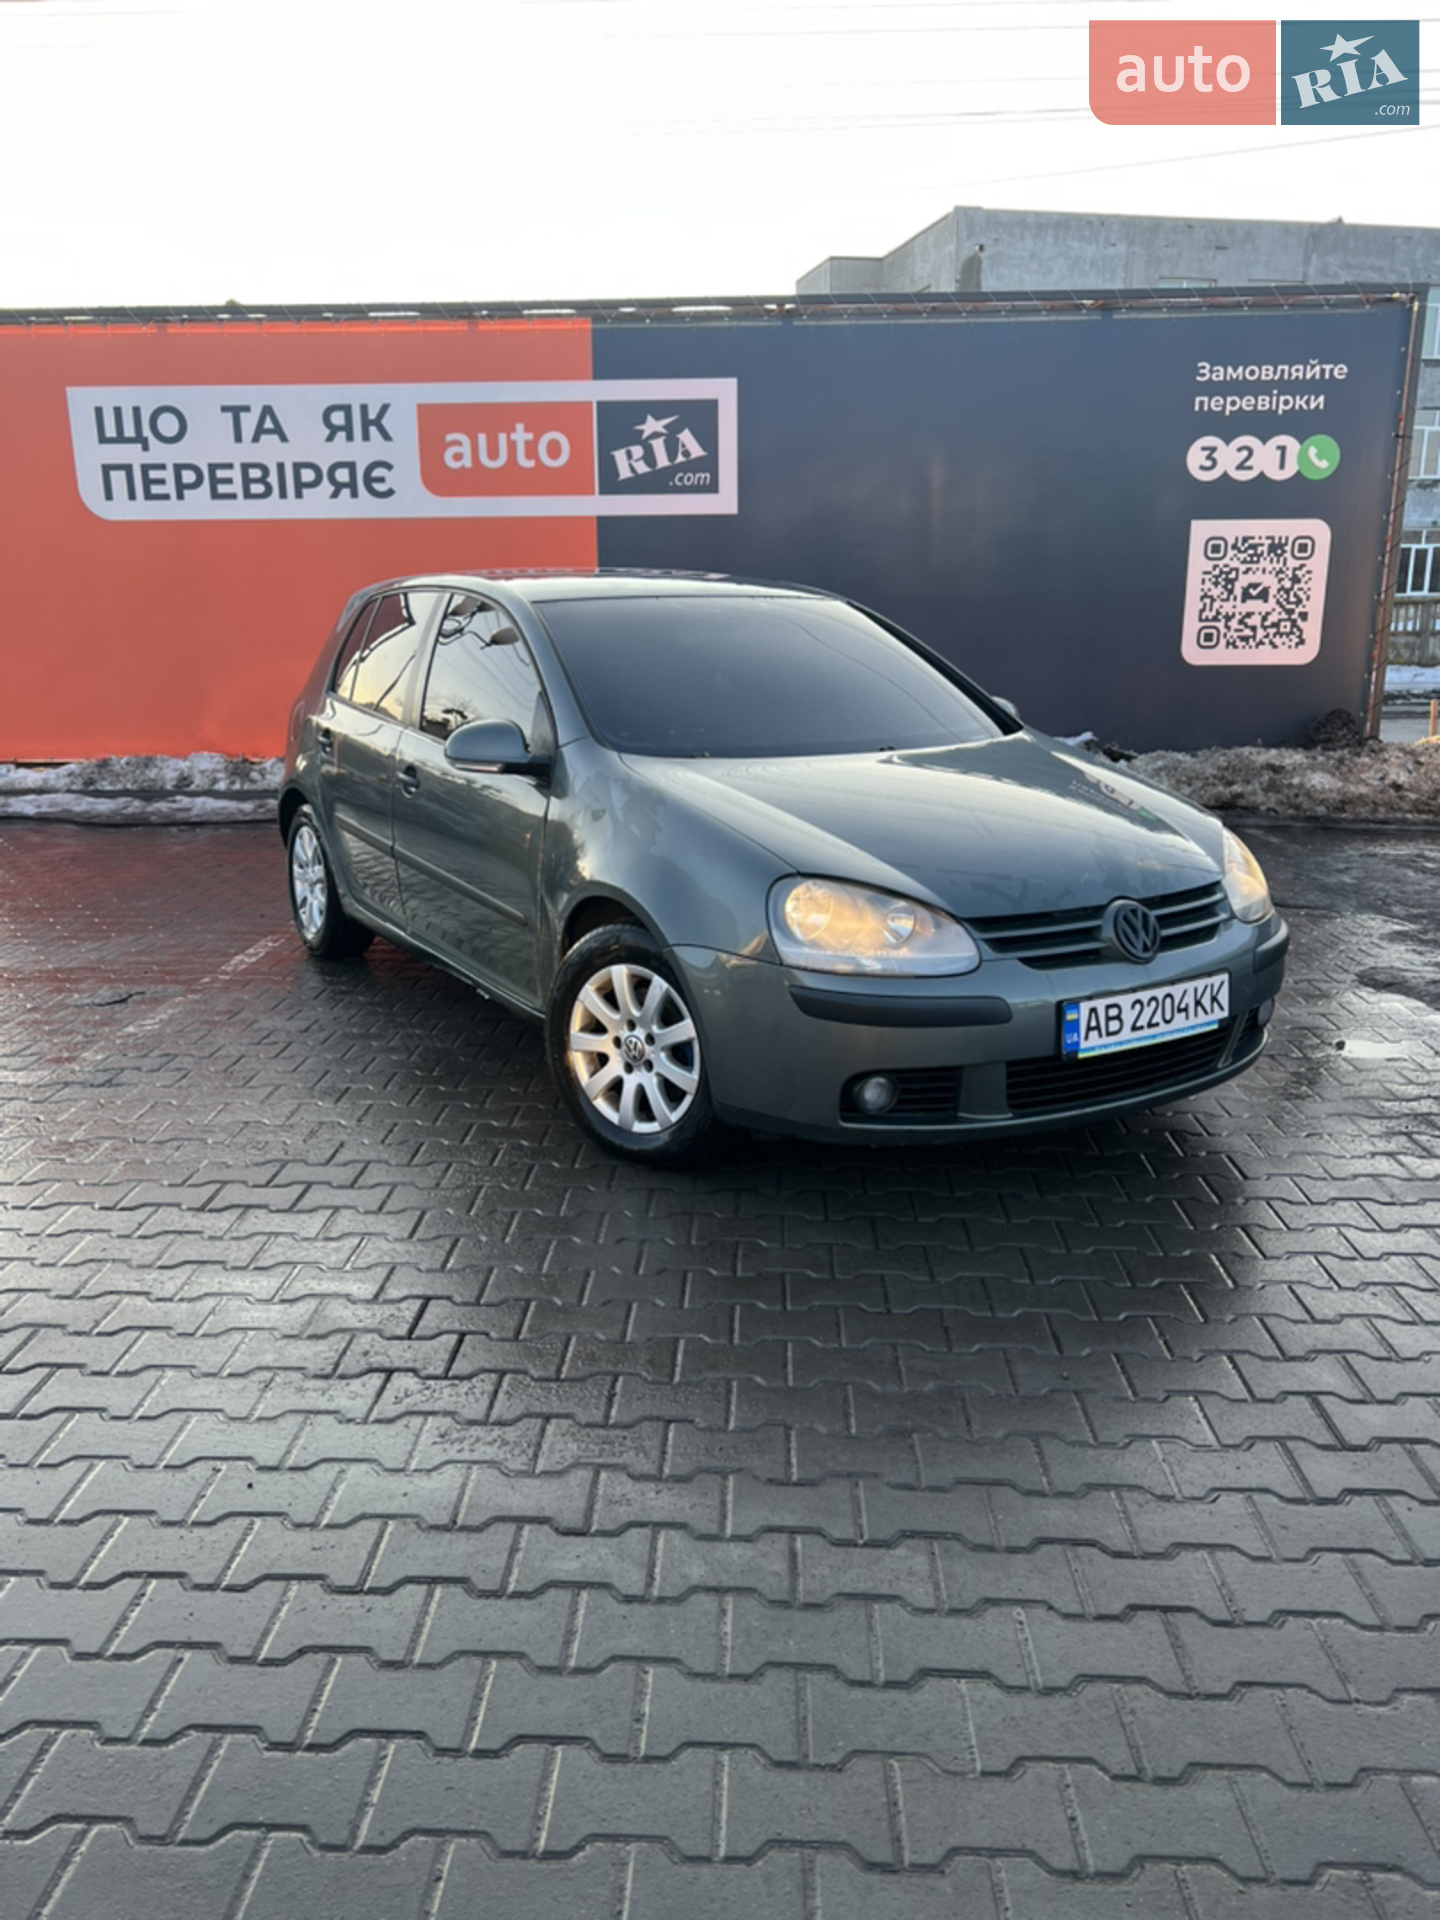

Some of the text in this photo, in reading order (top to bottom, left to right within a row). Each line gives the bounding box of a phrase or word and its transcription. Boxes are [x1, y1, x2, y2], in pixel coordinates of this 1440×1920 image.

[1195, 358, 1349, 382] Замовляйте
[1193, 389, 1325, 416] перевірки
[94, 403, 394, 452] ЩО ТА ЯК
[443, 422, 708, 481] auto RIA
[100, 459, 396, 502] ПЕРЕВІРЯЄ
[668, 471, 711, 486] .com
[1083, 1002, 1125, 1042] AB
